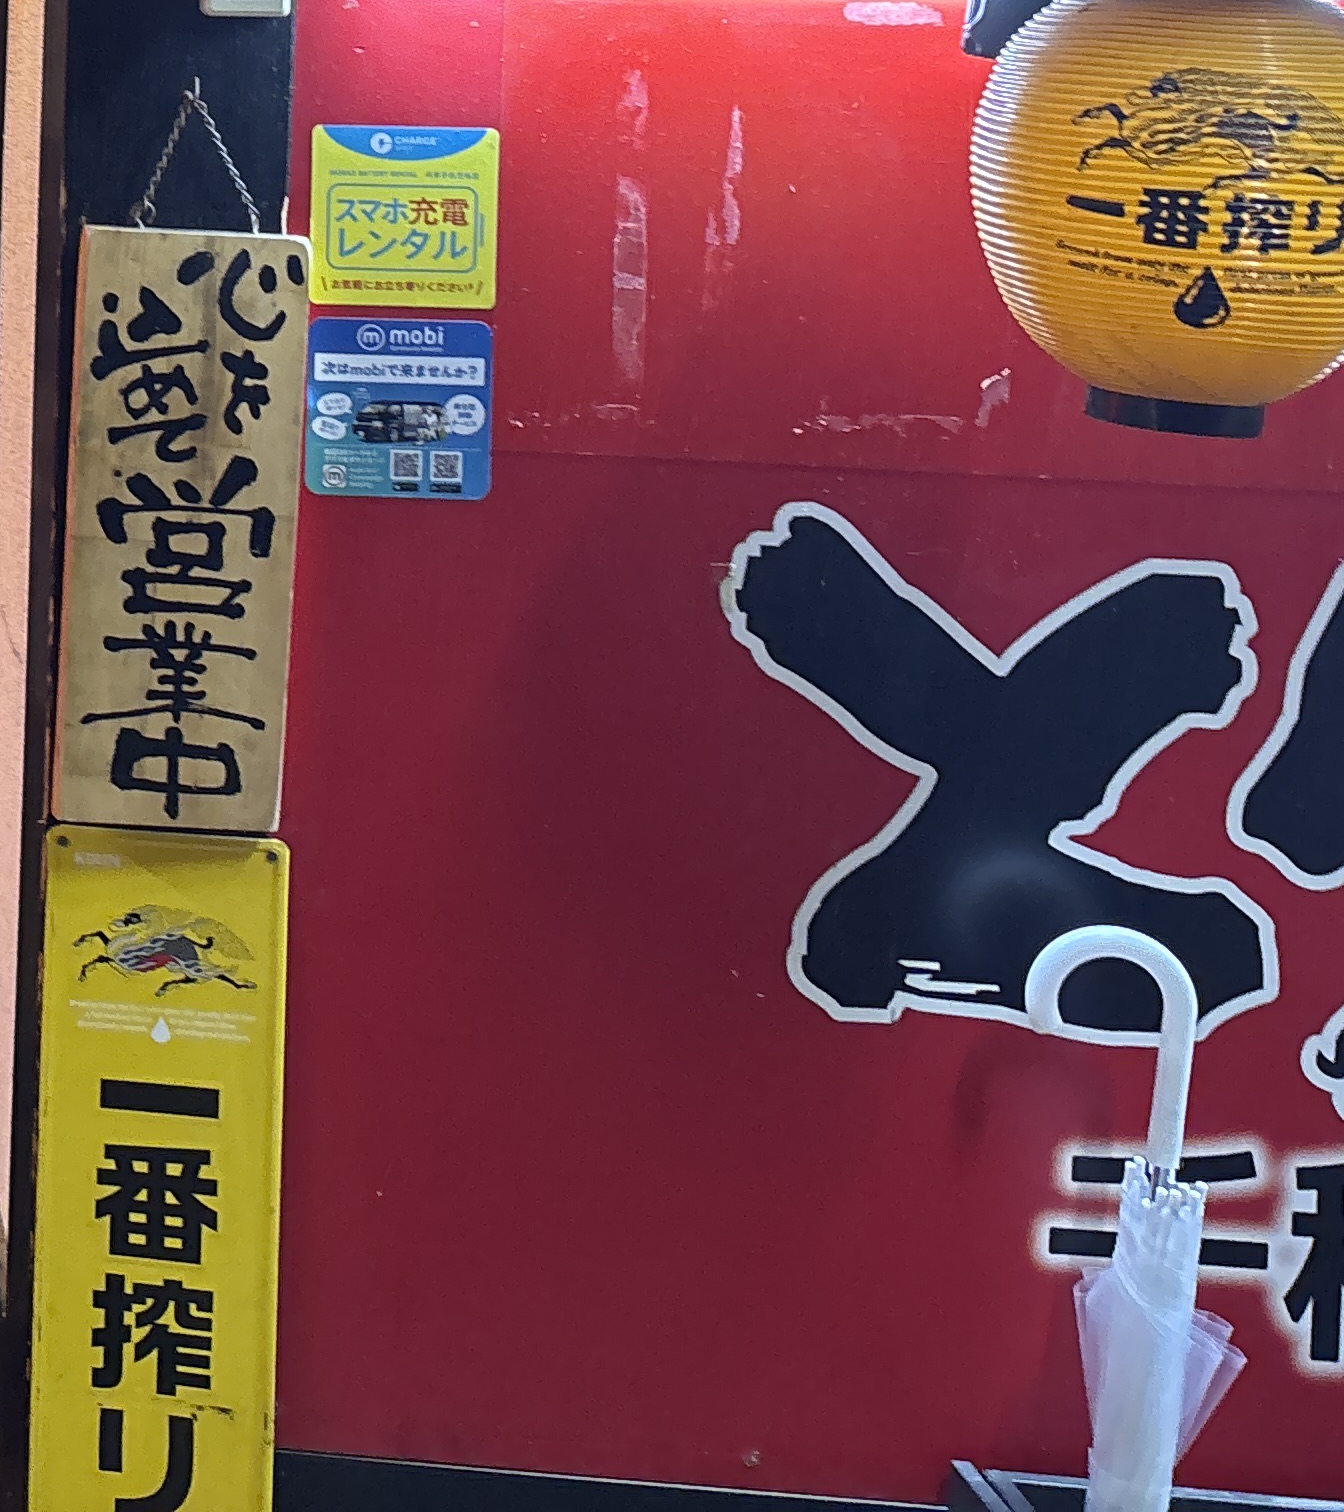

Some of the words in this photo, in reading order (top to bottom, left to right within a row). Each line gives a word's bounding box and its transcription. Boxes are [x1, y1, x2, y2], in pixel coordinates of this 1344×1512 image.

[335, 197, 469, 227] スマホ充電
[338, 227, 468, 261] レンタル
[389, 326, 445, 346] mobi
[81, 456, 275, 820] 営業中
[91, 1078, 220, 1512] 一番搾り
